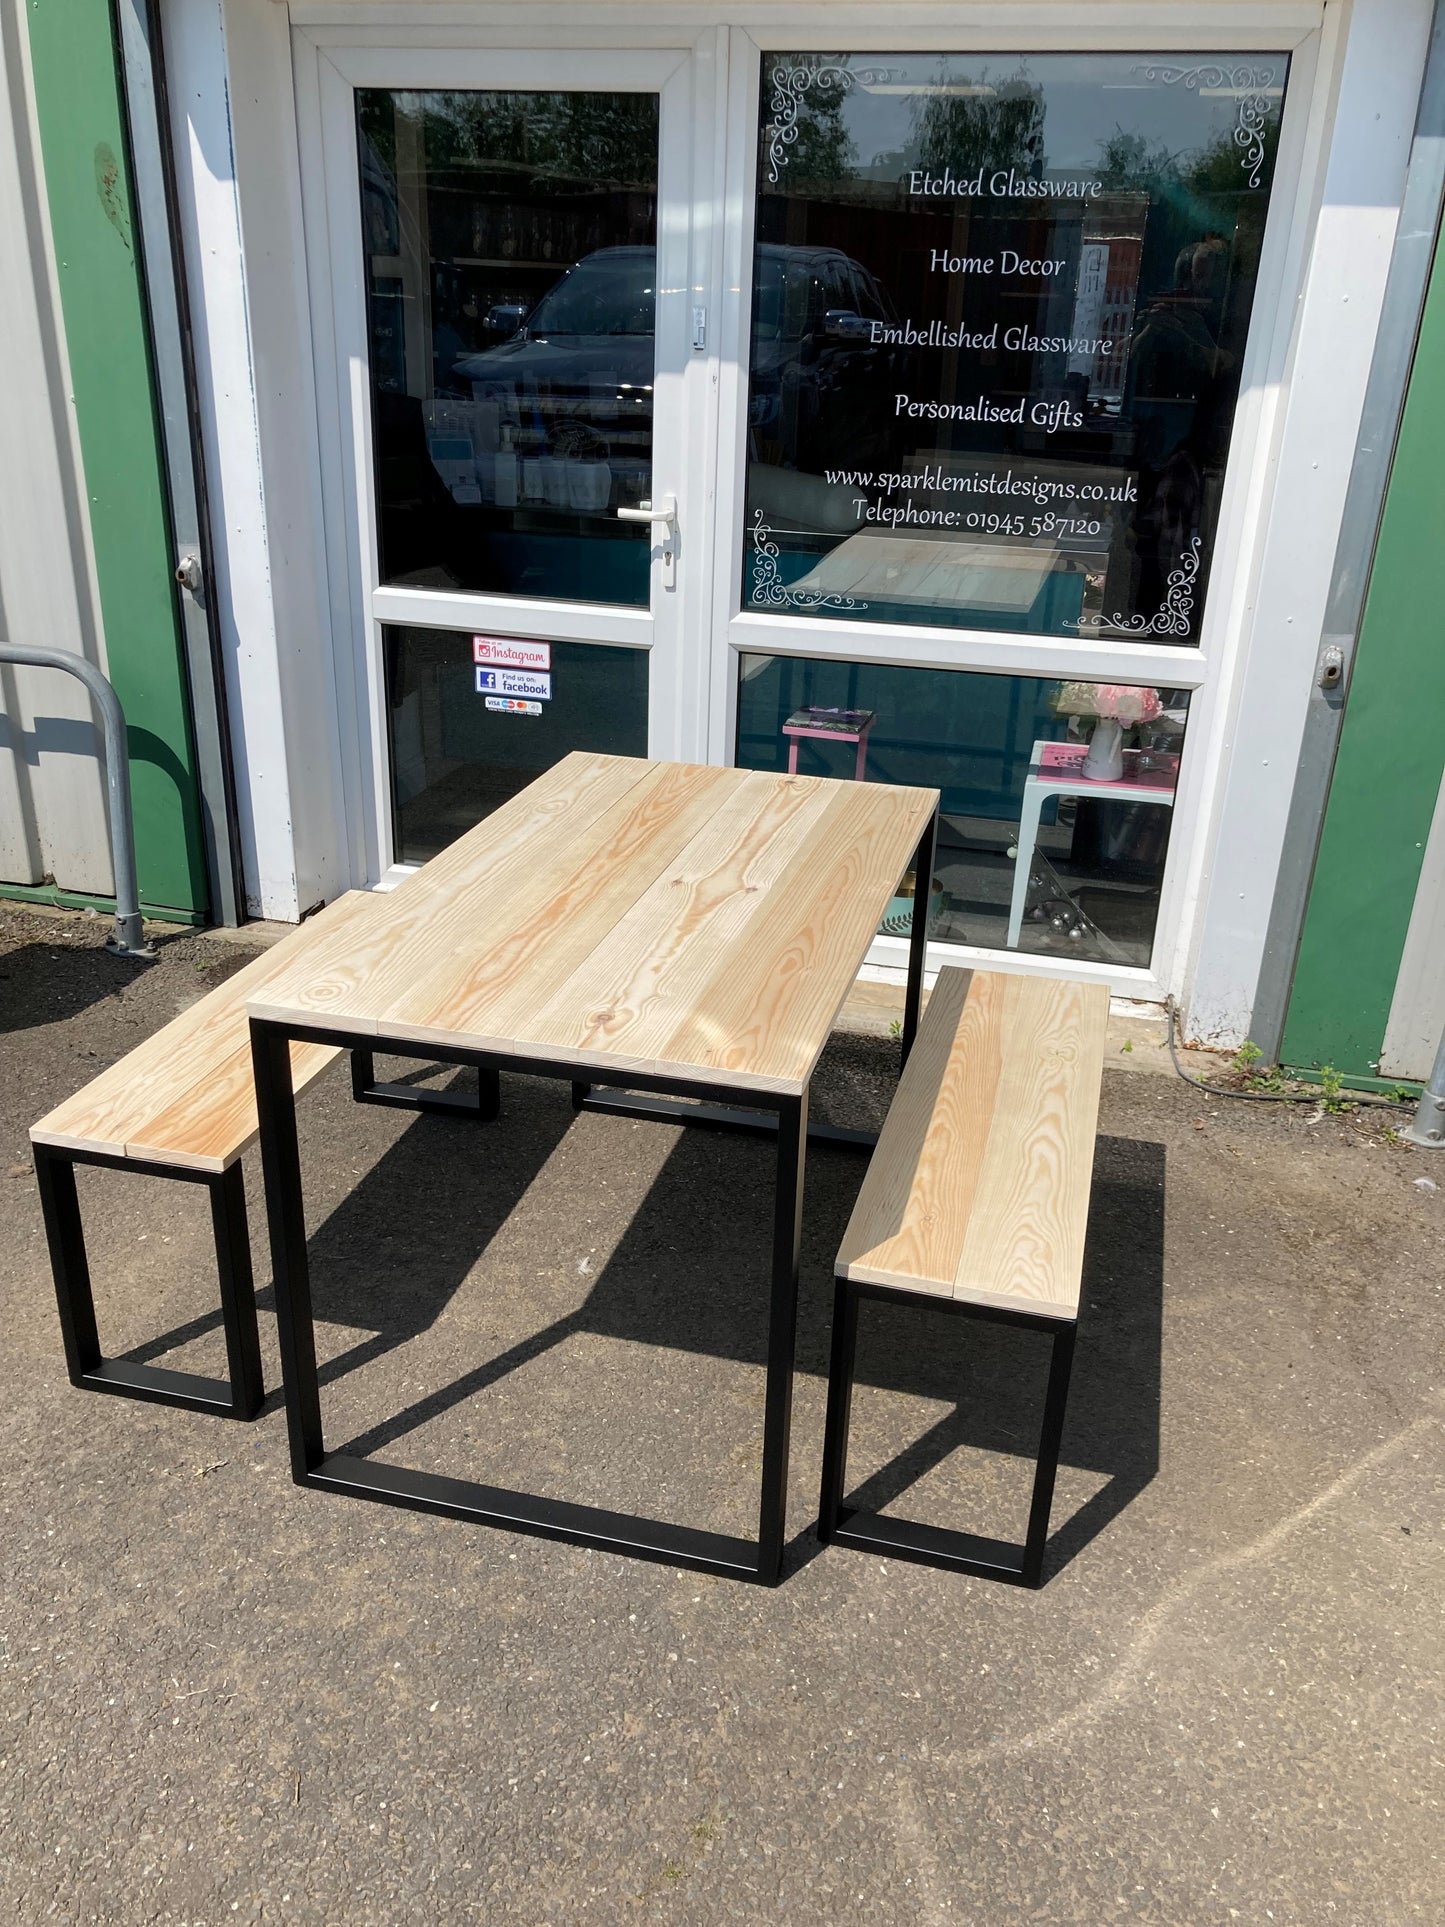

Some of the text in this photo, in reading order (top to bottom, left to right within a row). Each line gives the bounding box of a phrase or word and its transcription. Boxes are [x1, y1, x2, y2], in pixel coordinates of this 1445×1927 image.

[909, 167, 1103, 199] Etched Glassware
[930, 249, 1066, 277] Home Decor
[869, 320, 1113, 356] Embellished Glassware
[894, 394, 1084, 434] Personalised Gifts
[824, 465, 1139, 505] www.sparklemistdesigns.co.uk
[852, 498, 1101, 539] Telephone: 01945 587120
[491, 646, 545, 664] Instagram
[502, 673, 516, 681] Find
[503, 681, 547, 695] facebook
